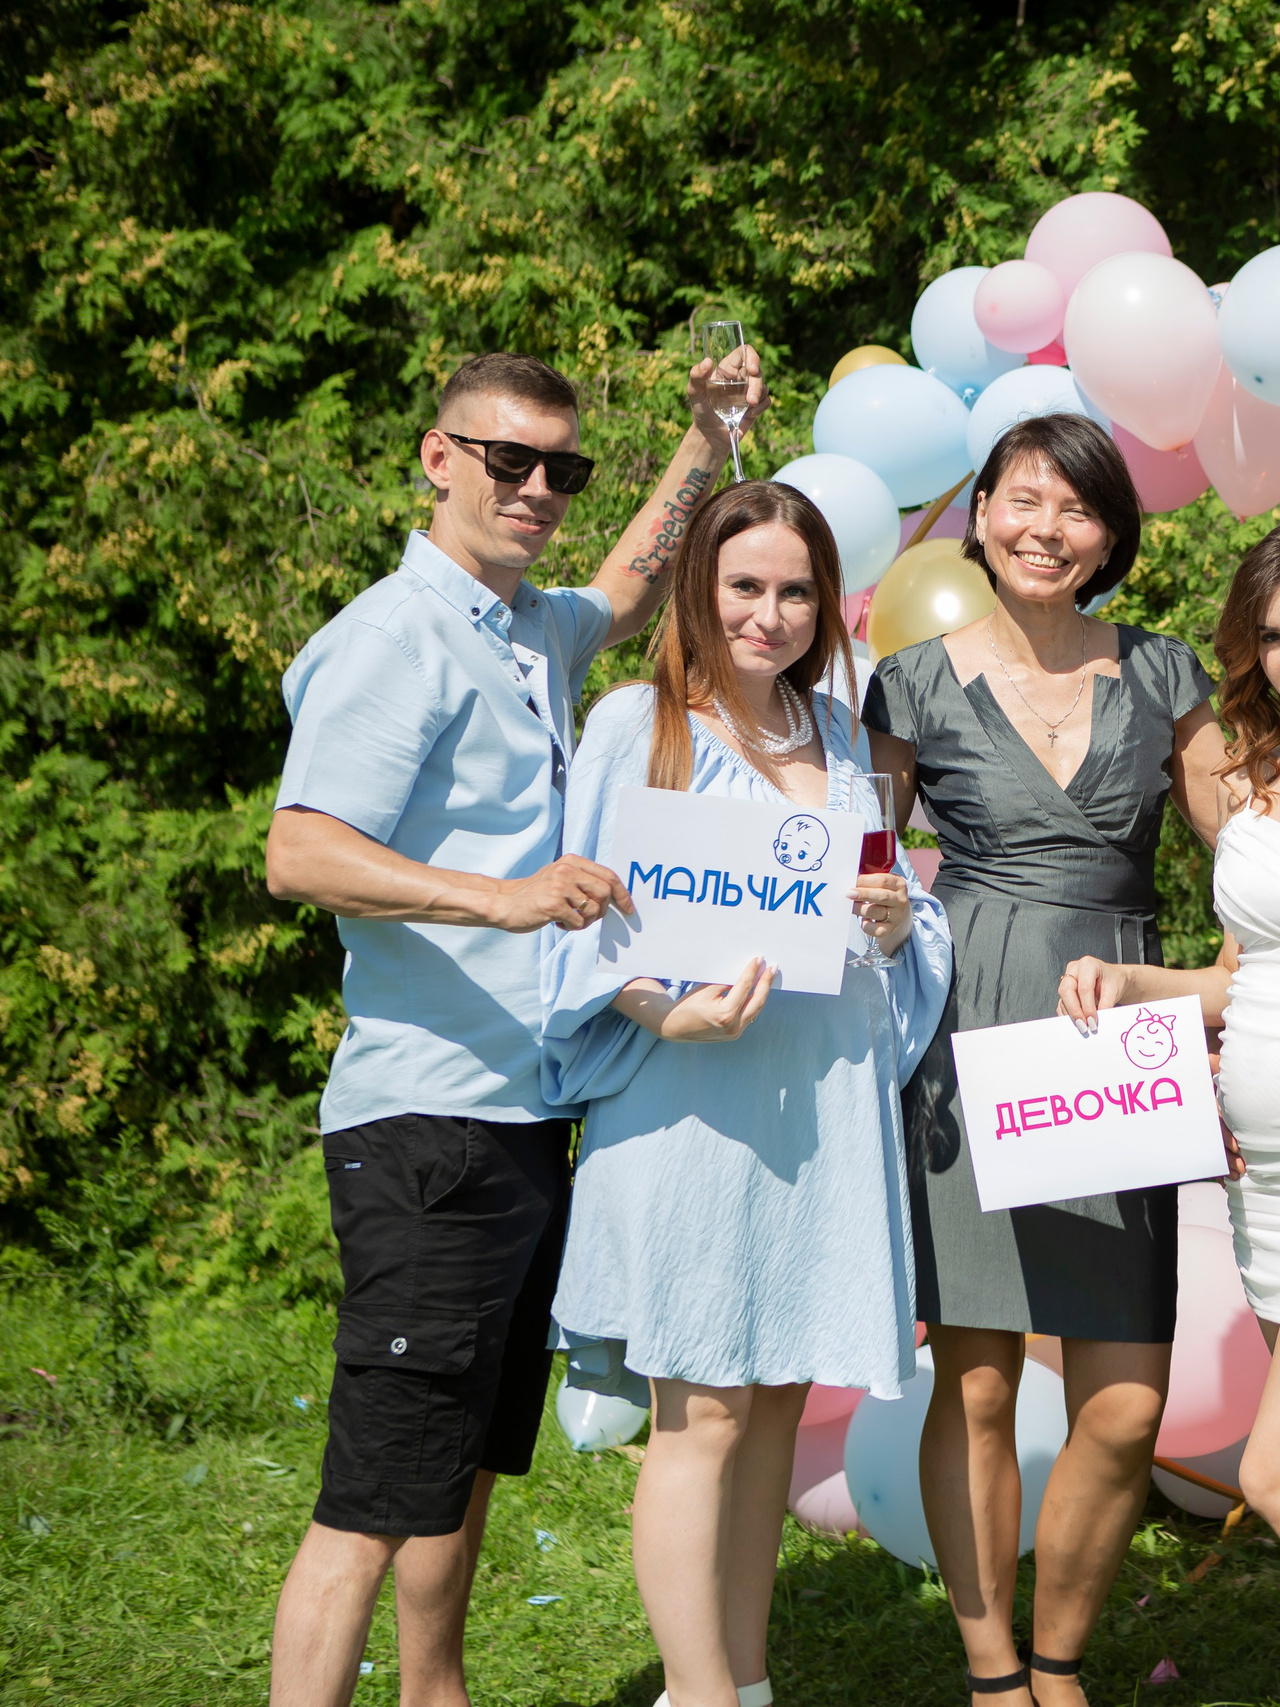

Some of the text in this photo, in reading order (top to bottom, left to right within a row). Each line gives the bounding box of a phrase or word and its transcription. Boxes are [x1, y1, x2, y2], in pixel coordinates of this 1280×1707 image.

[628, 466, 711, 584] Freedom
[628, 861, 828, 917] МАЛЬЧИК
[995, 1077, 1184, 1140] ДЕВОЧКА
